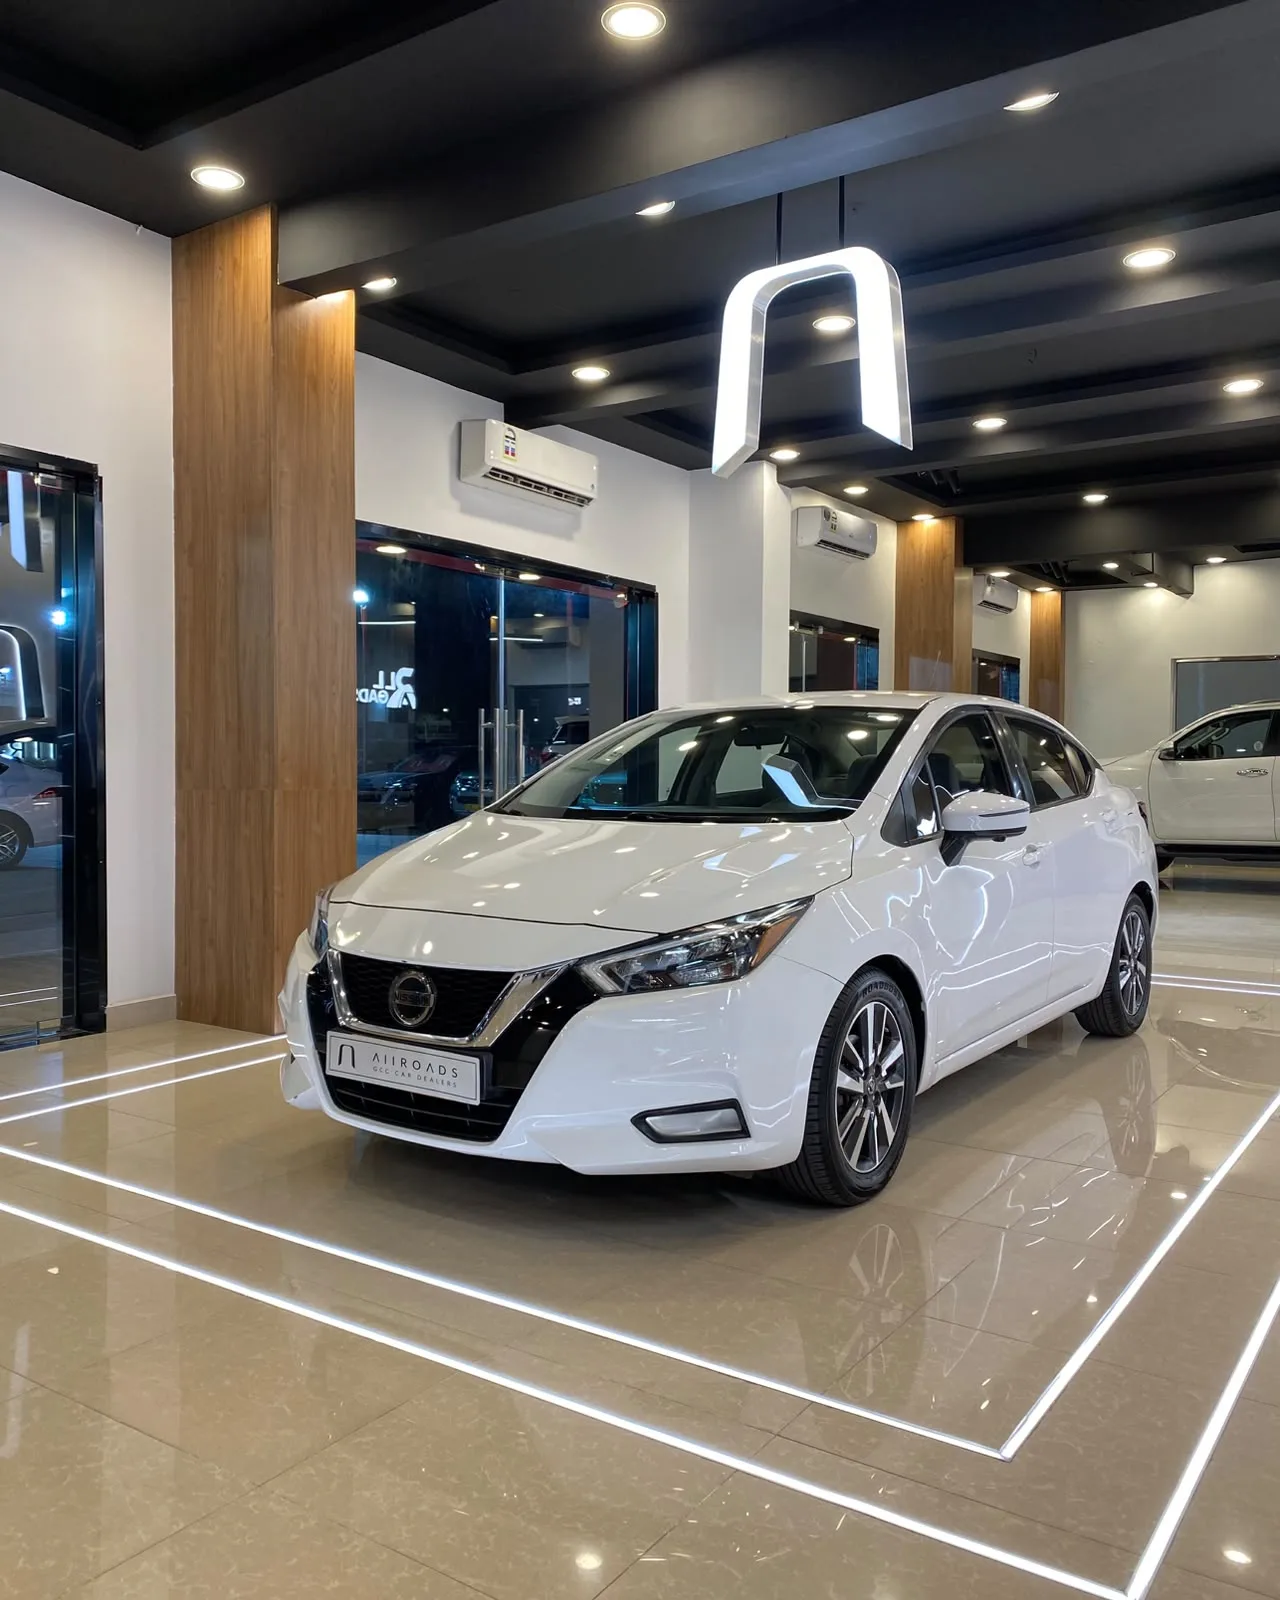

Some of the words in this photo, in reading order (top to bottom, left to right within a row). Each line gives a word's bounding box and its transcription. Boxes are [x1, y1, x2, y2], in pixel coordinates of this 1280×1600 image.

[373, 1065, 390, 1075] GCC
[394, 1070, 411, 1078] CAR
[417, 1074, 457, 1088] DEALERS
